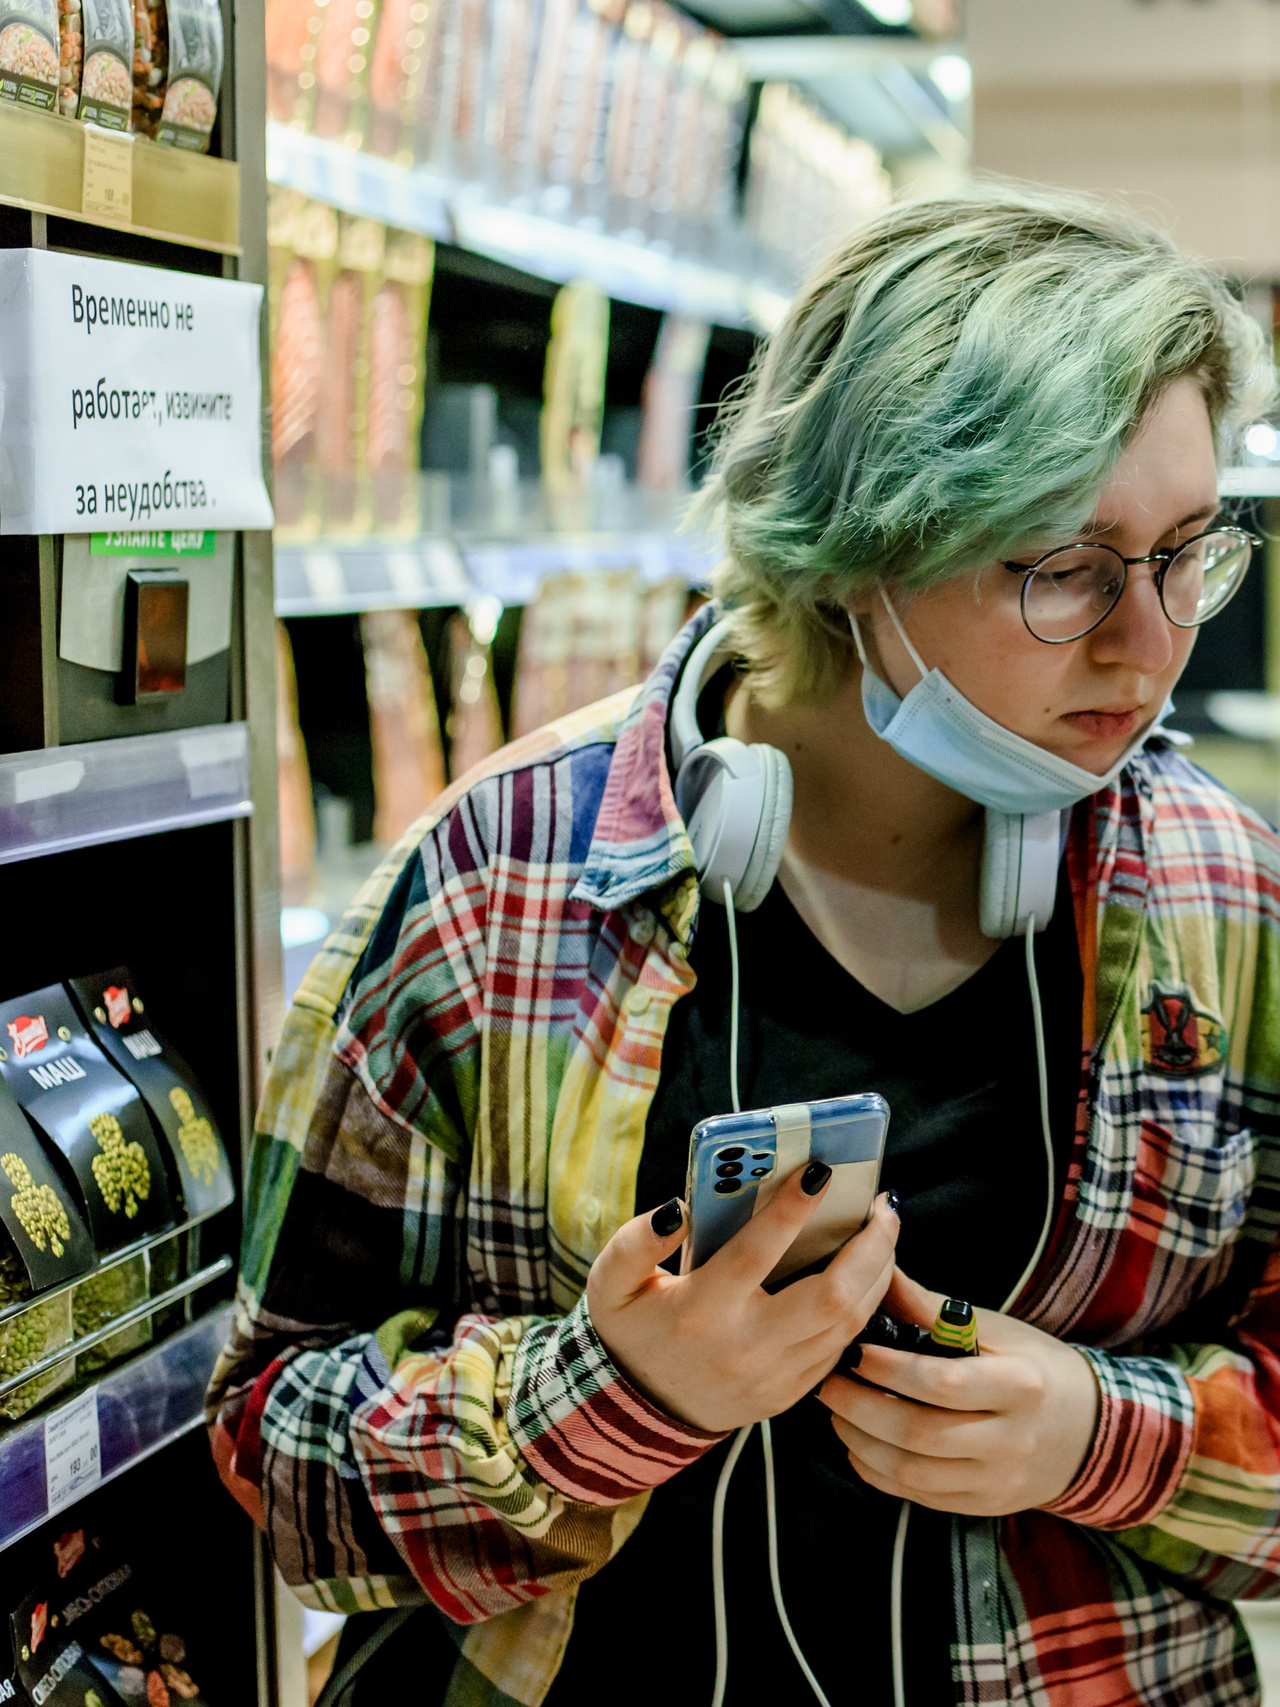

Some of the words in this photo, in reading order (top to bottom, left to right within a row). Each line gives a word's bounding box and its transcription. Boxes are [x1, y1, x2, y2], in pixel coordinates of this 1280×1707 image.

[72, 284, 170, 334] Временно
[175, 303, 194, 331] не
[165, 390, 233, 422] извините
[75, 484, 98, 515] за
[105, 470, 207, 521] неудобства
[28, 1055, 87, 1090] МАШ
